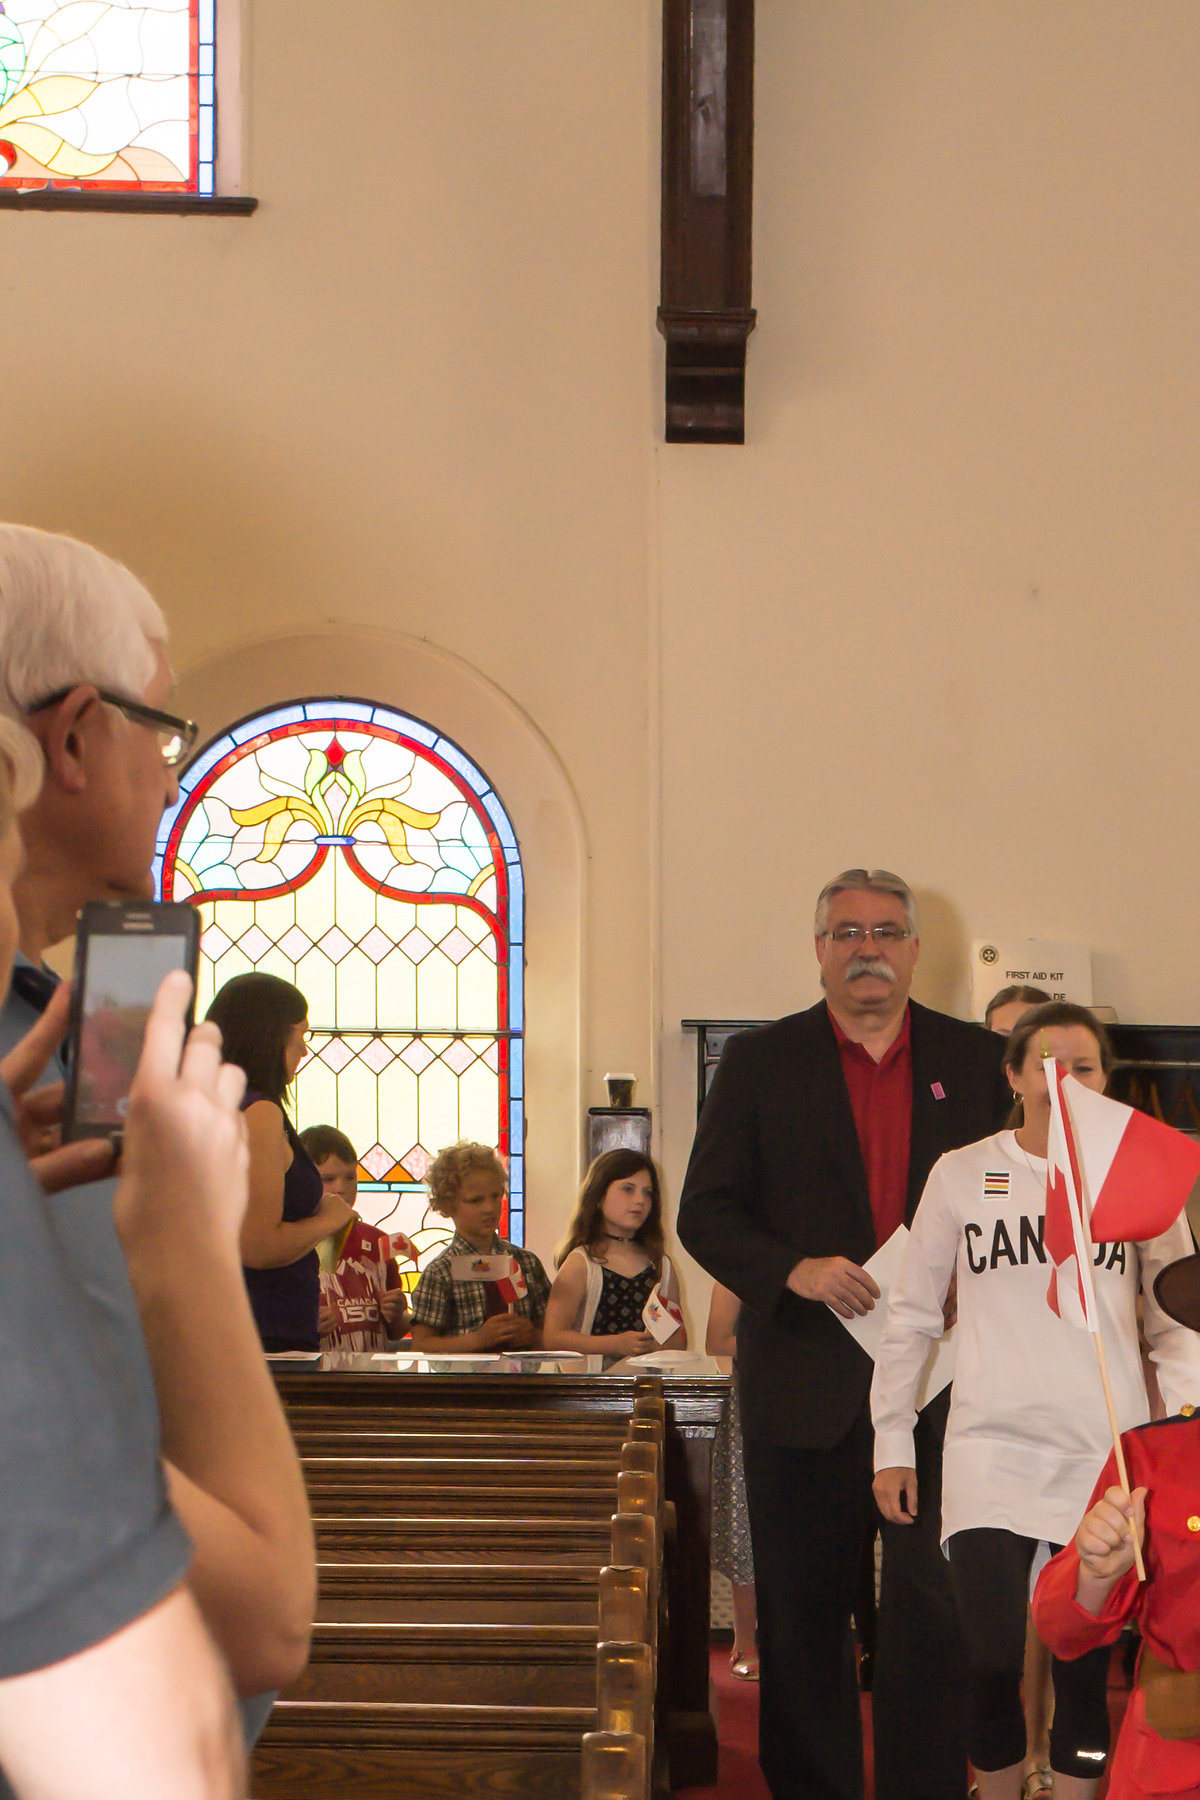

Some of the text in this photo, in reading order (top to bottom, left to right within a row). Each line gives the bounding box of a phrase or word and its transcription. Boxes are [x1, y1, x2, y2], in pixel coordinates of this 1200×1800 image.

[1005, 970, 1065, 981] FIRST AID KIT
[964, 1214, 1126, 1276] CANA
[337, 1297, 379, 1307] CANADA
[339, 1305, 380, 1324] 150
